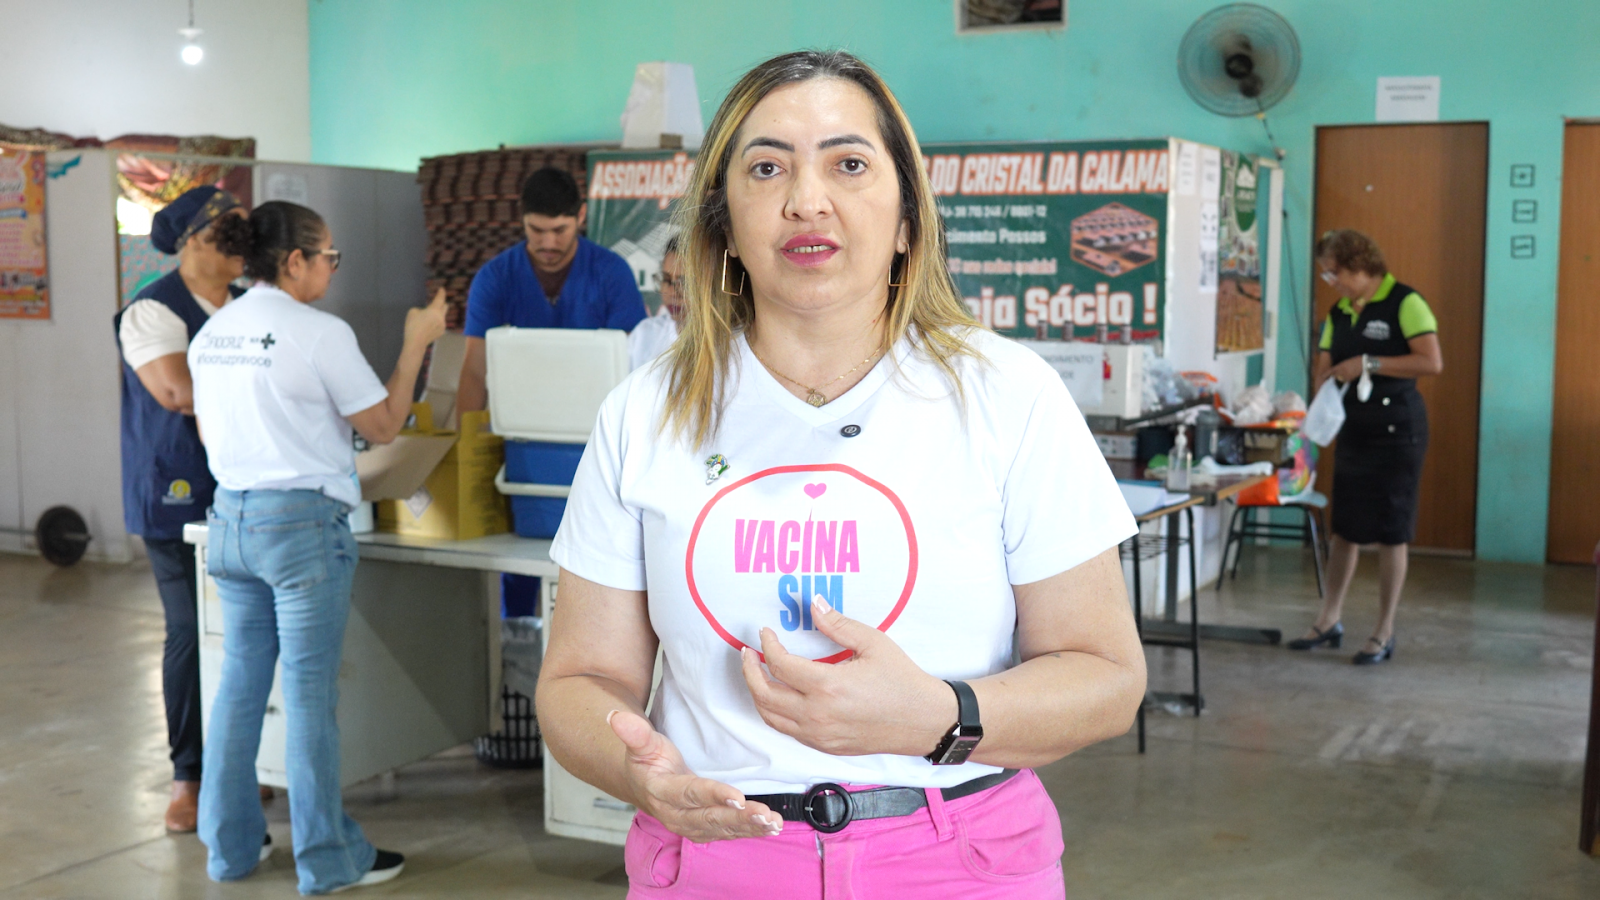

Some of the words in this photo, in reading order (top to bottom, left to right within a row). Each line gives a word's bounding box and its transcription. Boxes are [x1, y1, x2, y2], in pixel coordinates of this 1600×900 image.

[931, 154, 961, 195] DO
[960, 152, 1045, 194] CRISTAL
[1047, 151, 1079, 193] DA
[1079, 150, 1169, 193] CALAMA
[945, 227, 997, 244] cimento
[962, 286, 1017, 330] eja
[1024, 282, 1133, 328] Sócio
[1143, 283, 1158, 325] !
[734, 516, 860, 575] VACINA
[778, 574, 843, 632] SIM
